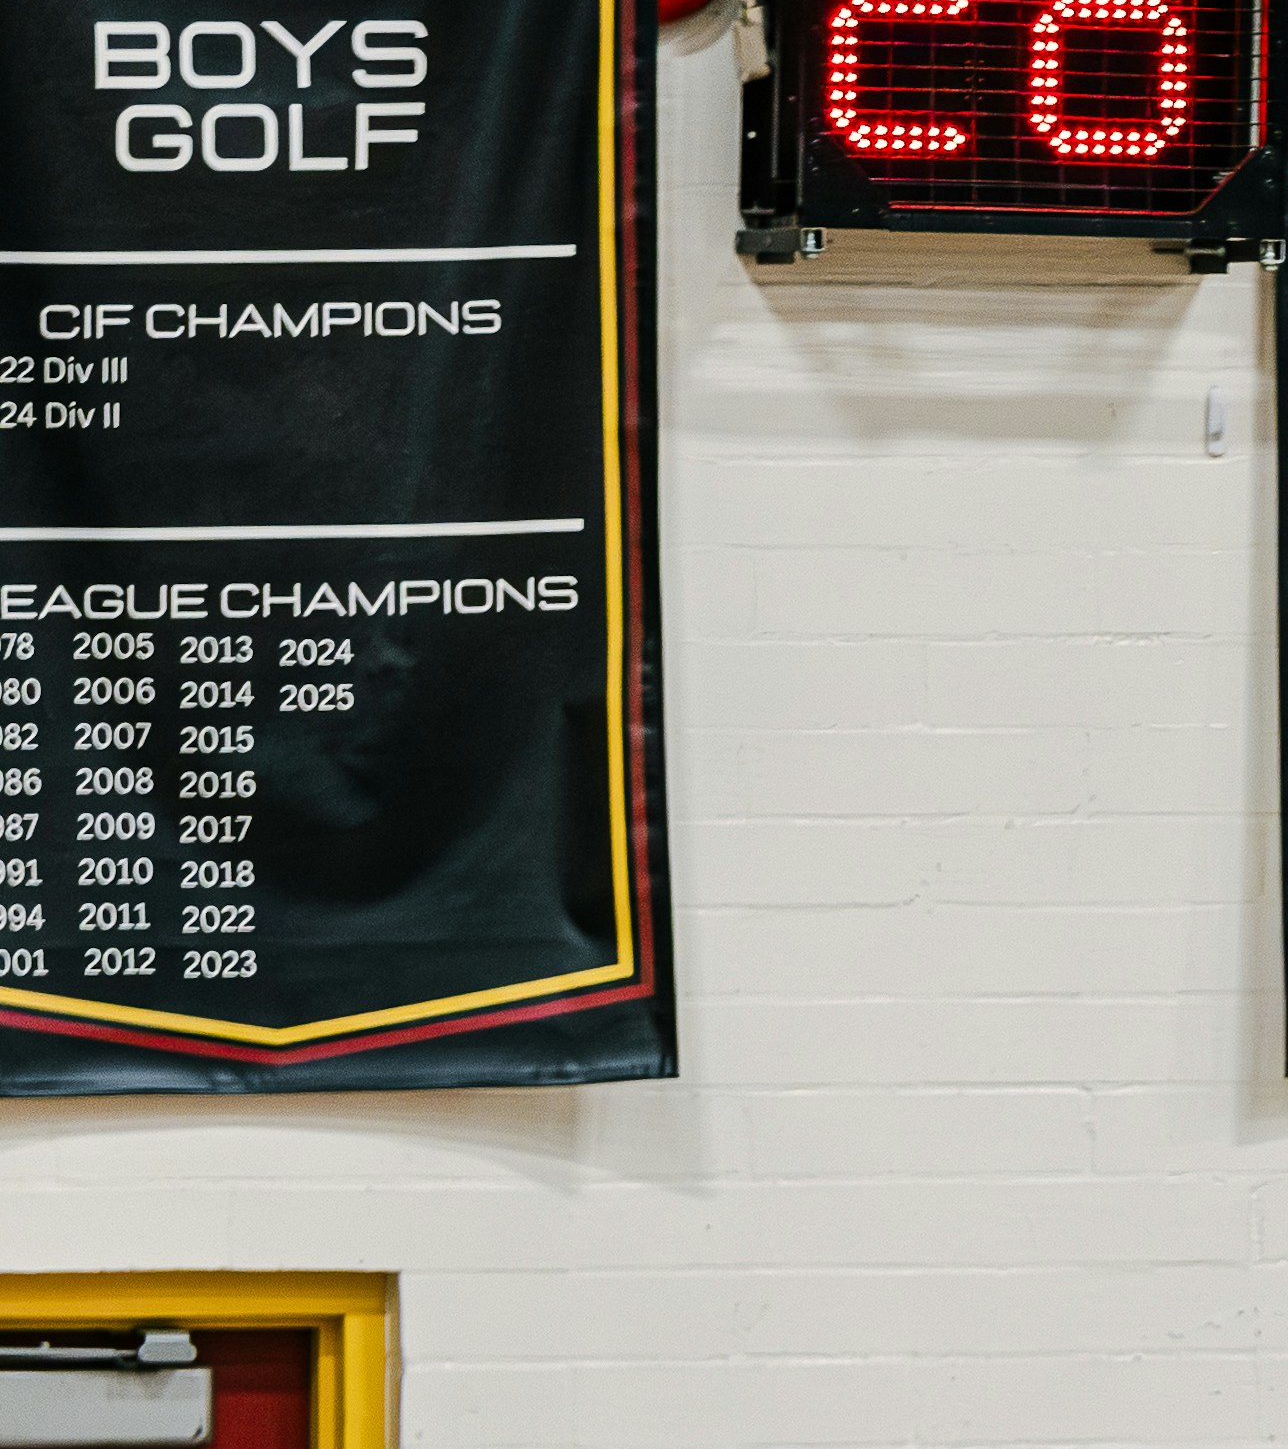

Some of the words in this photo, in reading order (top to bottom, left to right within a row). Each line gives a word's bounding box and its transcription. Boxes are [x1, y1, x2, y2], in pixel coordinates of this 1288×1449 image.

[93, 19, 429, 90] BOYS
[115, 101, 426, 172] GOLF
[39, 303, 134, 340] CIF
[145, 298, 502, 339] CHAMPIONS
[43, 355, 95, 384] Div
[101, 356, 128, 384] III
[45, 400, 96, 429] Div
[103, 402, 121, 429] II
[220, 575, 579, 619] CHAMPIONS
[72, 631, 155, 661] 2005
[179, 635, 254, 664] 2013
[278, 638, 355, 667] 2024
[73, 676, 156, 706] 2006
[179, 680, 256, 709] 2014
[279, 683, 355, 712] 2025
[73, 721, 152, 751] 2007
[179, 725, 255, 754] 2015
[75, 766, 155, 796] 2008
[179, 770, 257, 799] 2016
[76, 811, 156, 841] 2009
[178, 814, 253, 844] 2017
[77, 856, 154, 886] 2010
[180, 859, 256, 889] 2018
[78, 901, 152, 931] 2011
[181, 904, 256, 934] 2022
[83, 946, 157, 976] 2012
[182, 949, 258, 979] 2023
